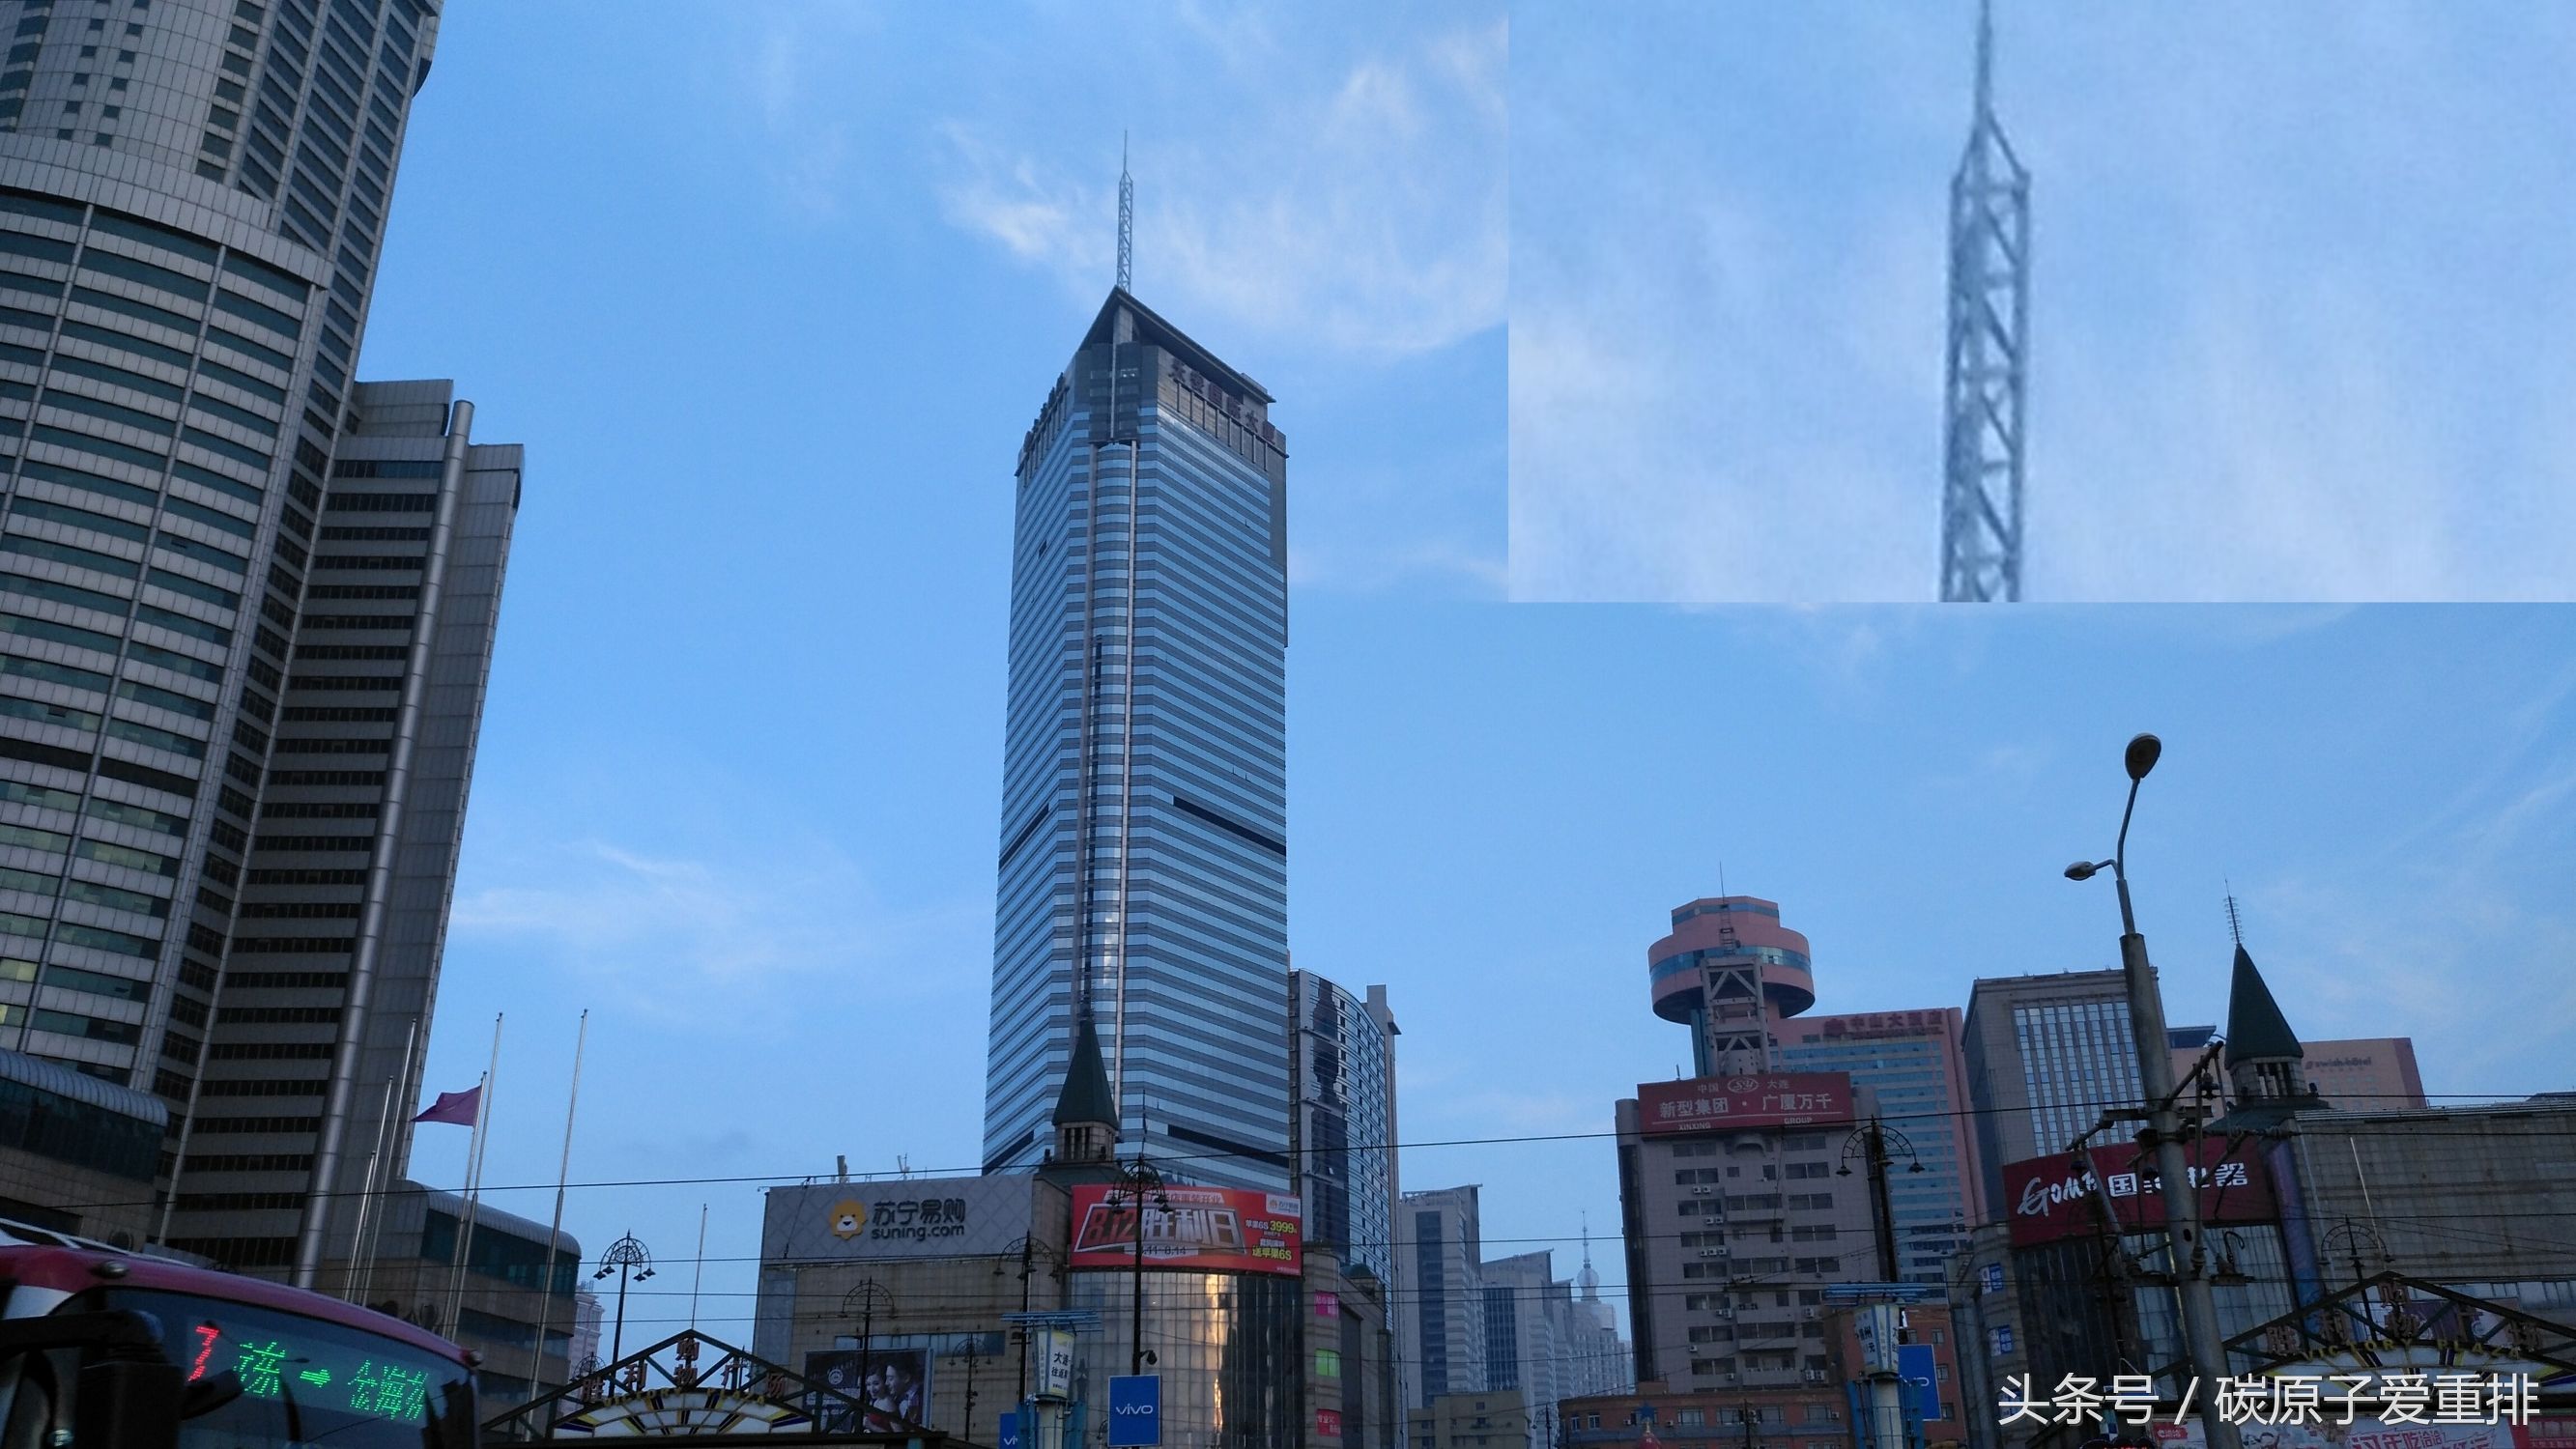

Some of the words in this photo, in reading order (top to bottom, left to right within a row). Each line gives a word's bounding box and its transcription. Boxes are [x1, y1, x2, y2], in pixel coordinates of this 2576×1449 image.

[1697, 1082, 1719, 1094] 中国
[1766, 1079, 1789, 1090] 大连
[1659, 1096, 1730, 1119] 新型集团
[1762, 1093, 1832, 1111] 广厦万千
[1784, 1116, 1813, 1125] GROUP
[873, 1198, 966, 1226] 苏宁易购
[872, 1225, 965, 1241] suning.com
[186, 1324, 220, 1382] 7
[2303, 1337, 2413, 1362] VICTORY
[2437, 1339, 2521, 1359] PLAZA
[1115, 1403, 1154, 1417] vivo
